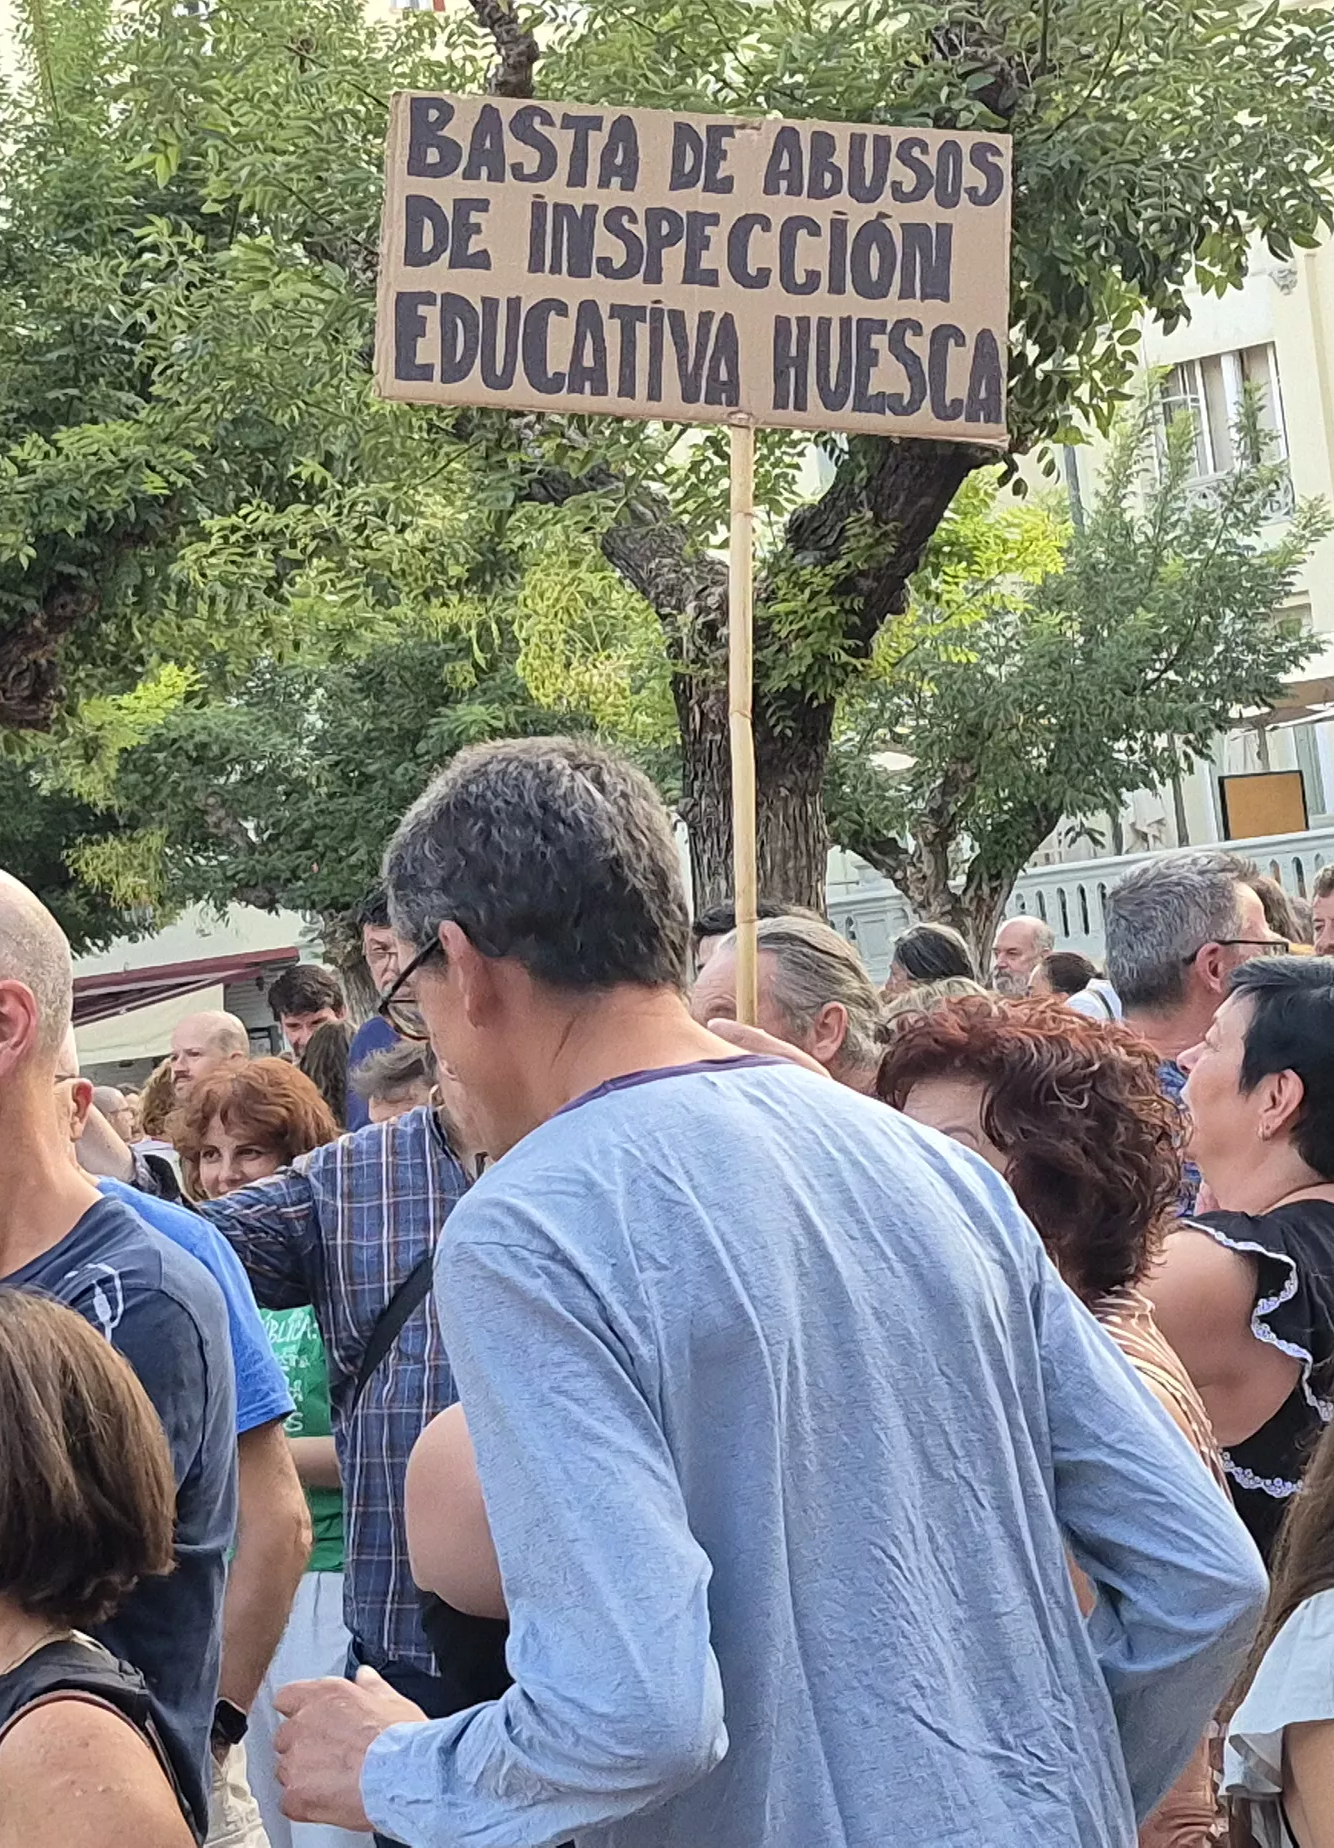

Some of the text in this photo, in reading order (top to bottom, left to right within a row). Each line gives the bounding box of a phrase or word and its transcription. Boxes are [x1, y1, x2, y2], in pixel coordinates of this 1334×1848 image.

[407, 96, 1005, 208] BASTA DE ABUSOS
[403, 194, 954, 302] DE INSPECCIÓN
[394, 290, 1006, 424] EDUCATIVA HUESCA
